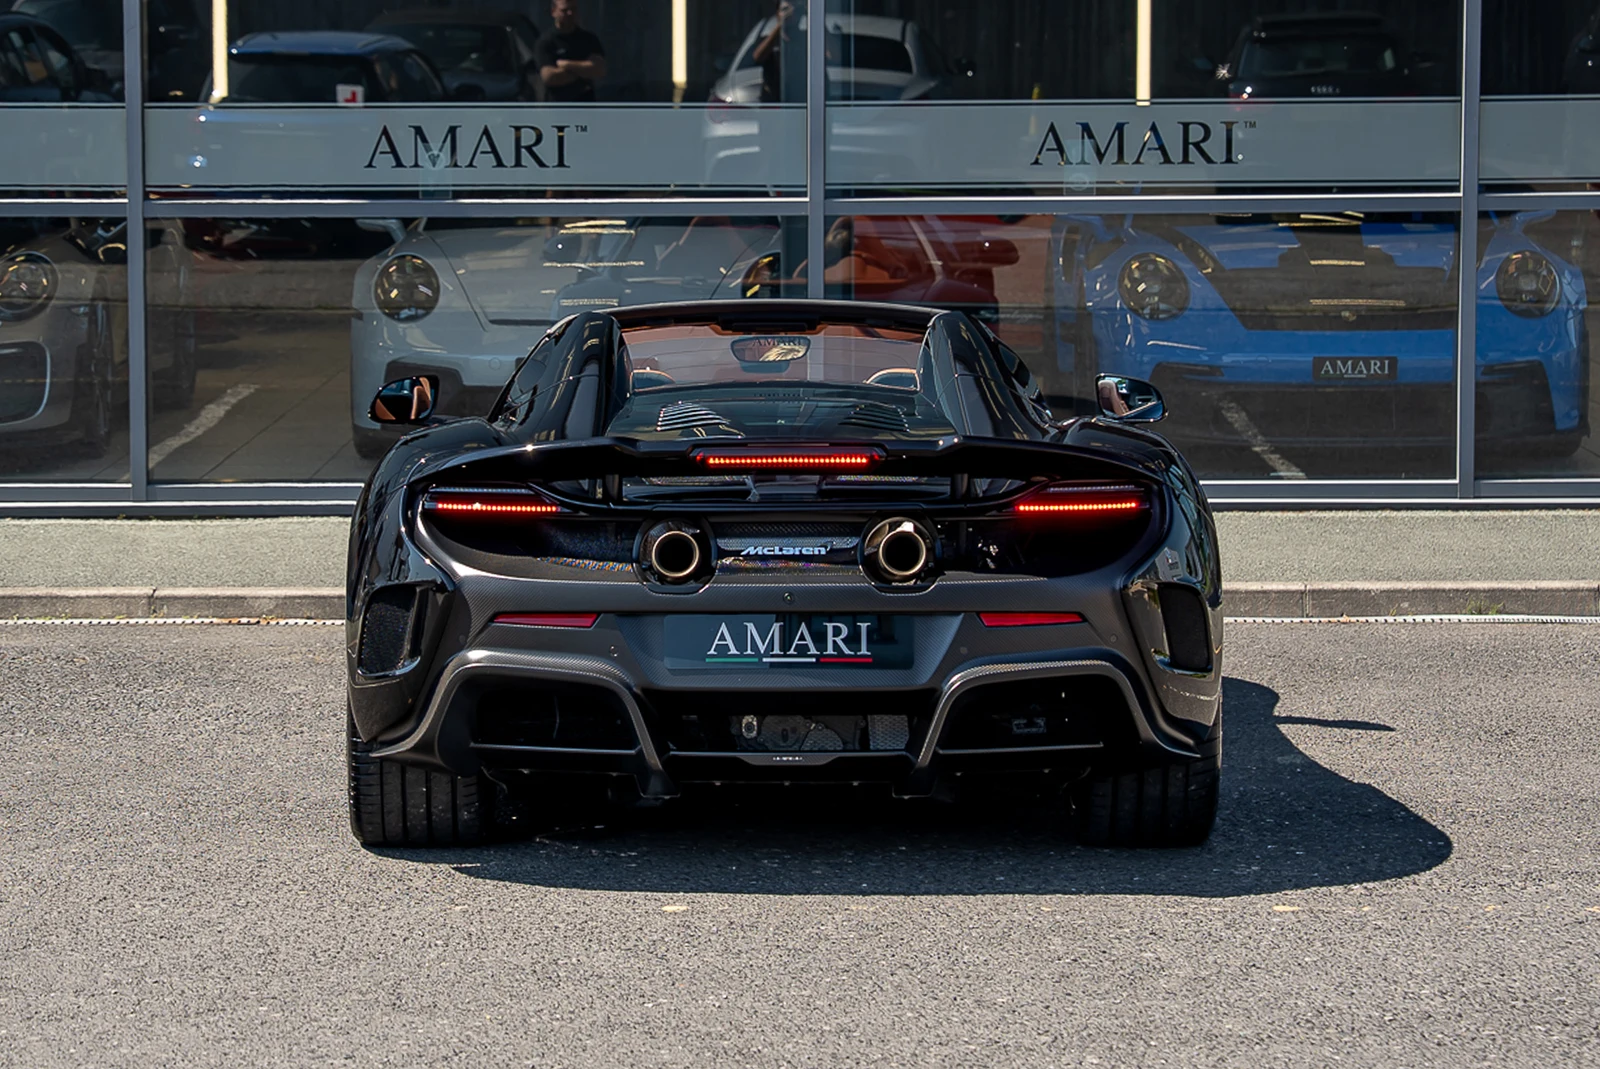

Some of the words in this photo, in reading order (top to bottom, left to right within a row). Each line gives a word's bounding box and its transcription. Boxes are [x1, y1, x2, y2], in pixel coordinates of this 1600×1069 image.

[363, 124, 571, 168] AMARI
[1030, 121, 1239, 165] AMARI
[1320, 359, 1390, 375] AMARI
[740, 545, 827, 556] McLaren
[706, 621, 872, 656] AMARI
